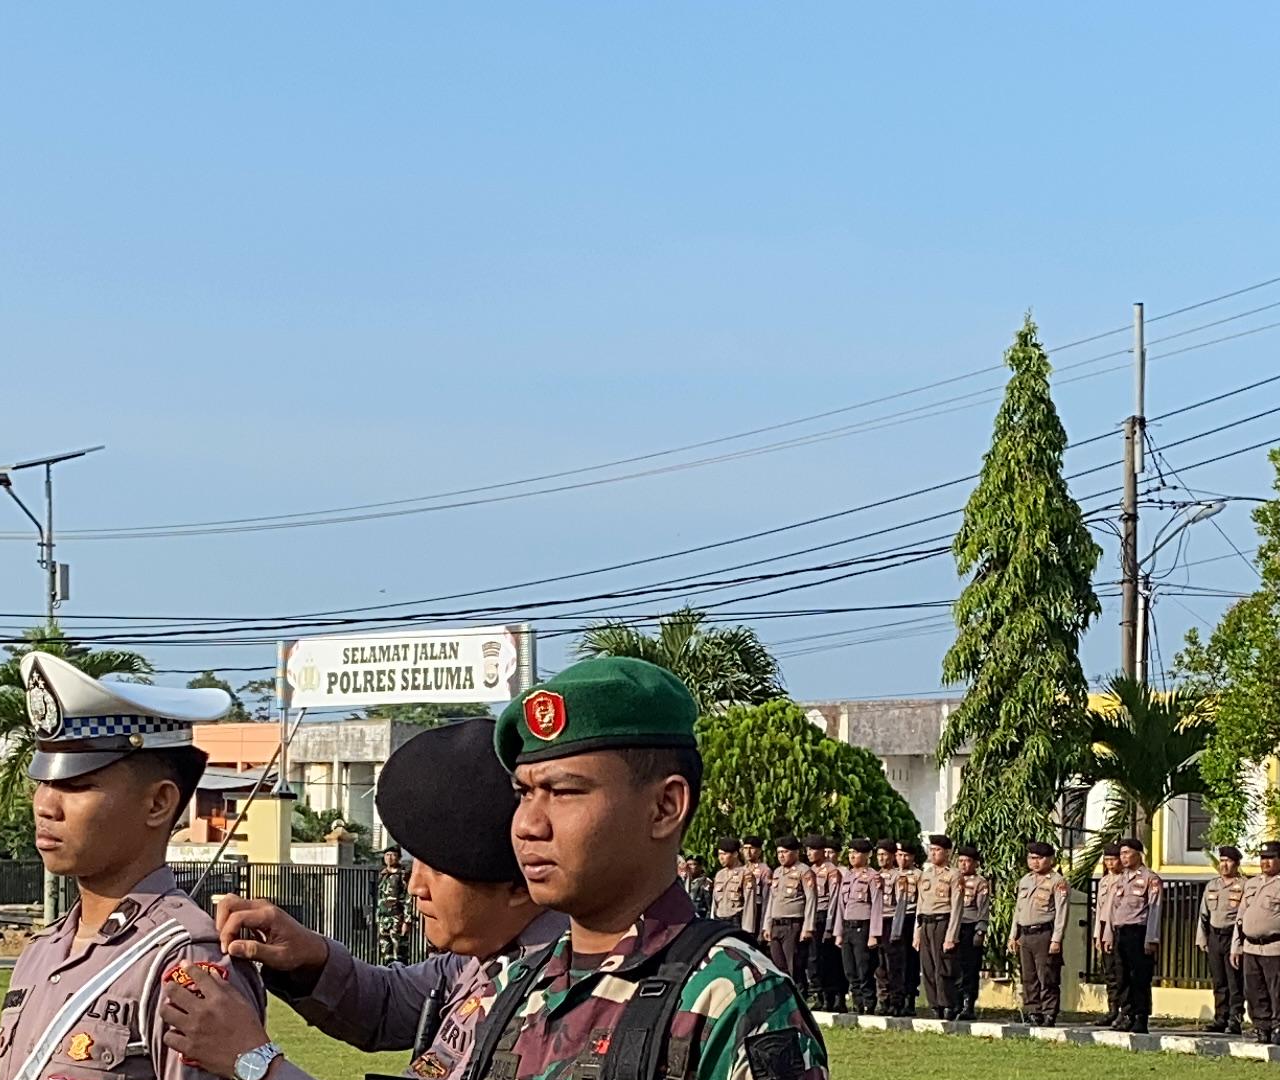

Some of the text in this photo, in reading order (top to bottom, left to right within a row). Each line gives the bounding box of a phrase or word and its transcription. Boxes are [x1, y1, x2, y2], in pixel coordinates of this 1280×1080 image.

[343, 641, 460, 665] SELAMAT JALAN
[326, 665, 475, 695] POLRES SELUMA
